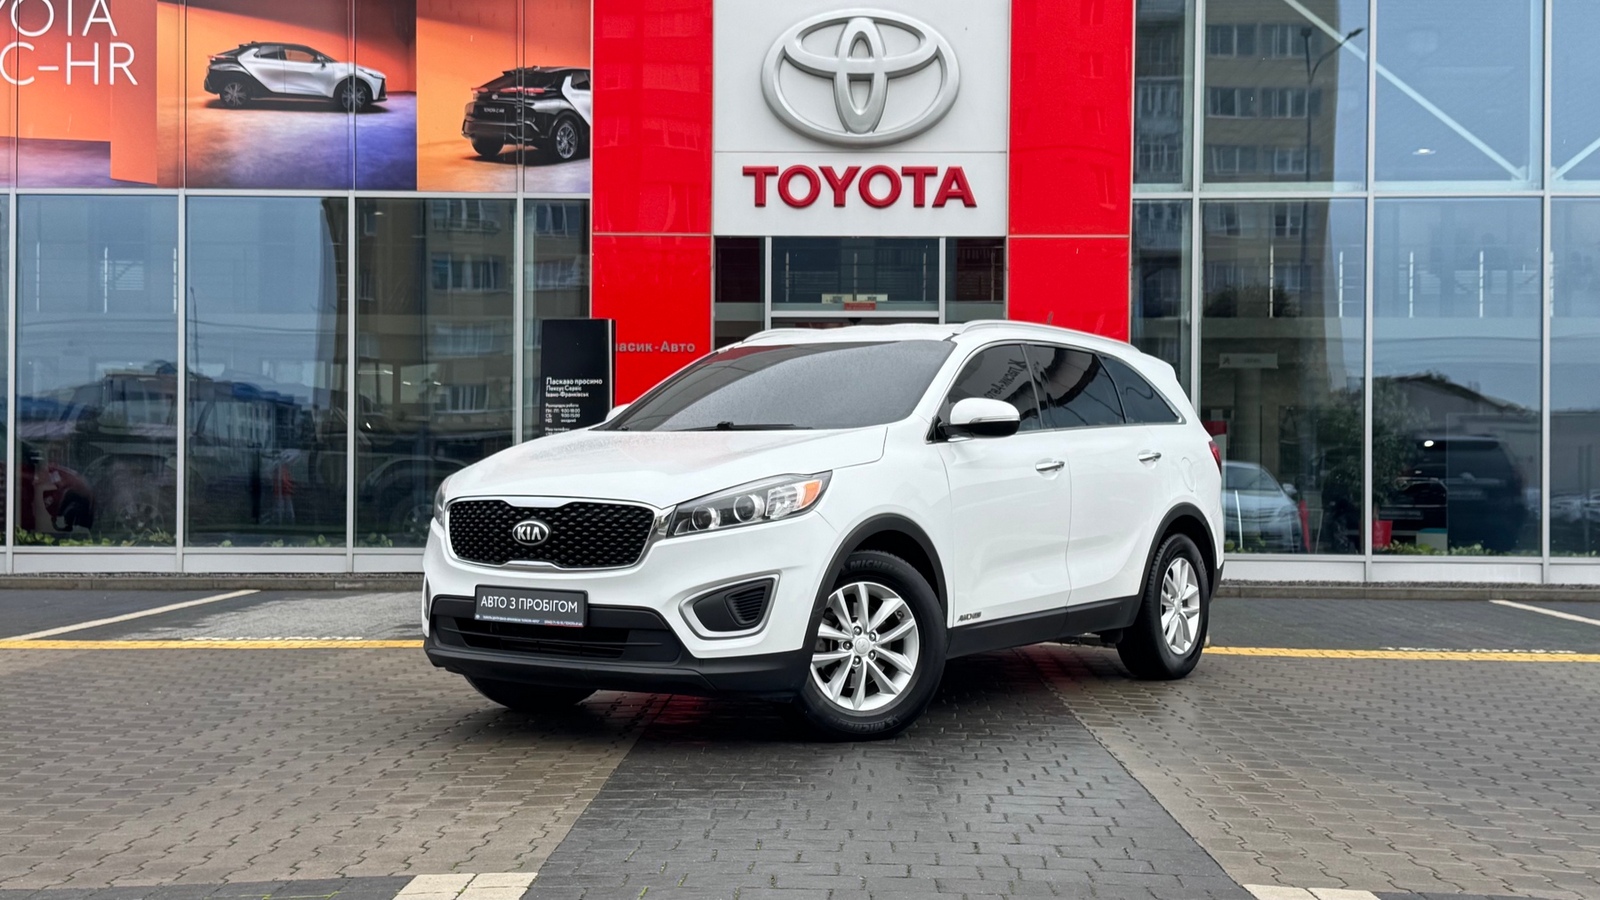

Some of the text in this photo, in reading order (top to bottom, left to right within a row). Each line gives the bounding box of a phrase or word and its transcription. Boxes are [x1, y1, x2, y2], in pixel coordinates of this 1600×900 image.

[0, 0, 118, 37] OTA
[0, 41, 138, 86] C-HR
[743, 165, 977, 208] TOYOTA
[517, 526, 541, 540] KIA
[480, 595, 508, 609] АВТО
[518, 598, 578, 613] ПРОБІГОМ
